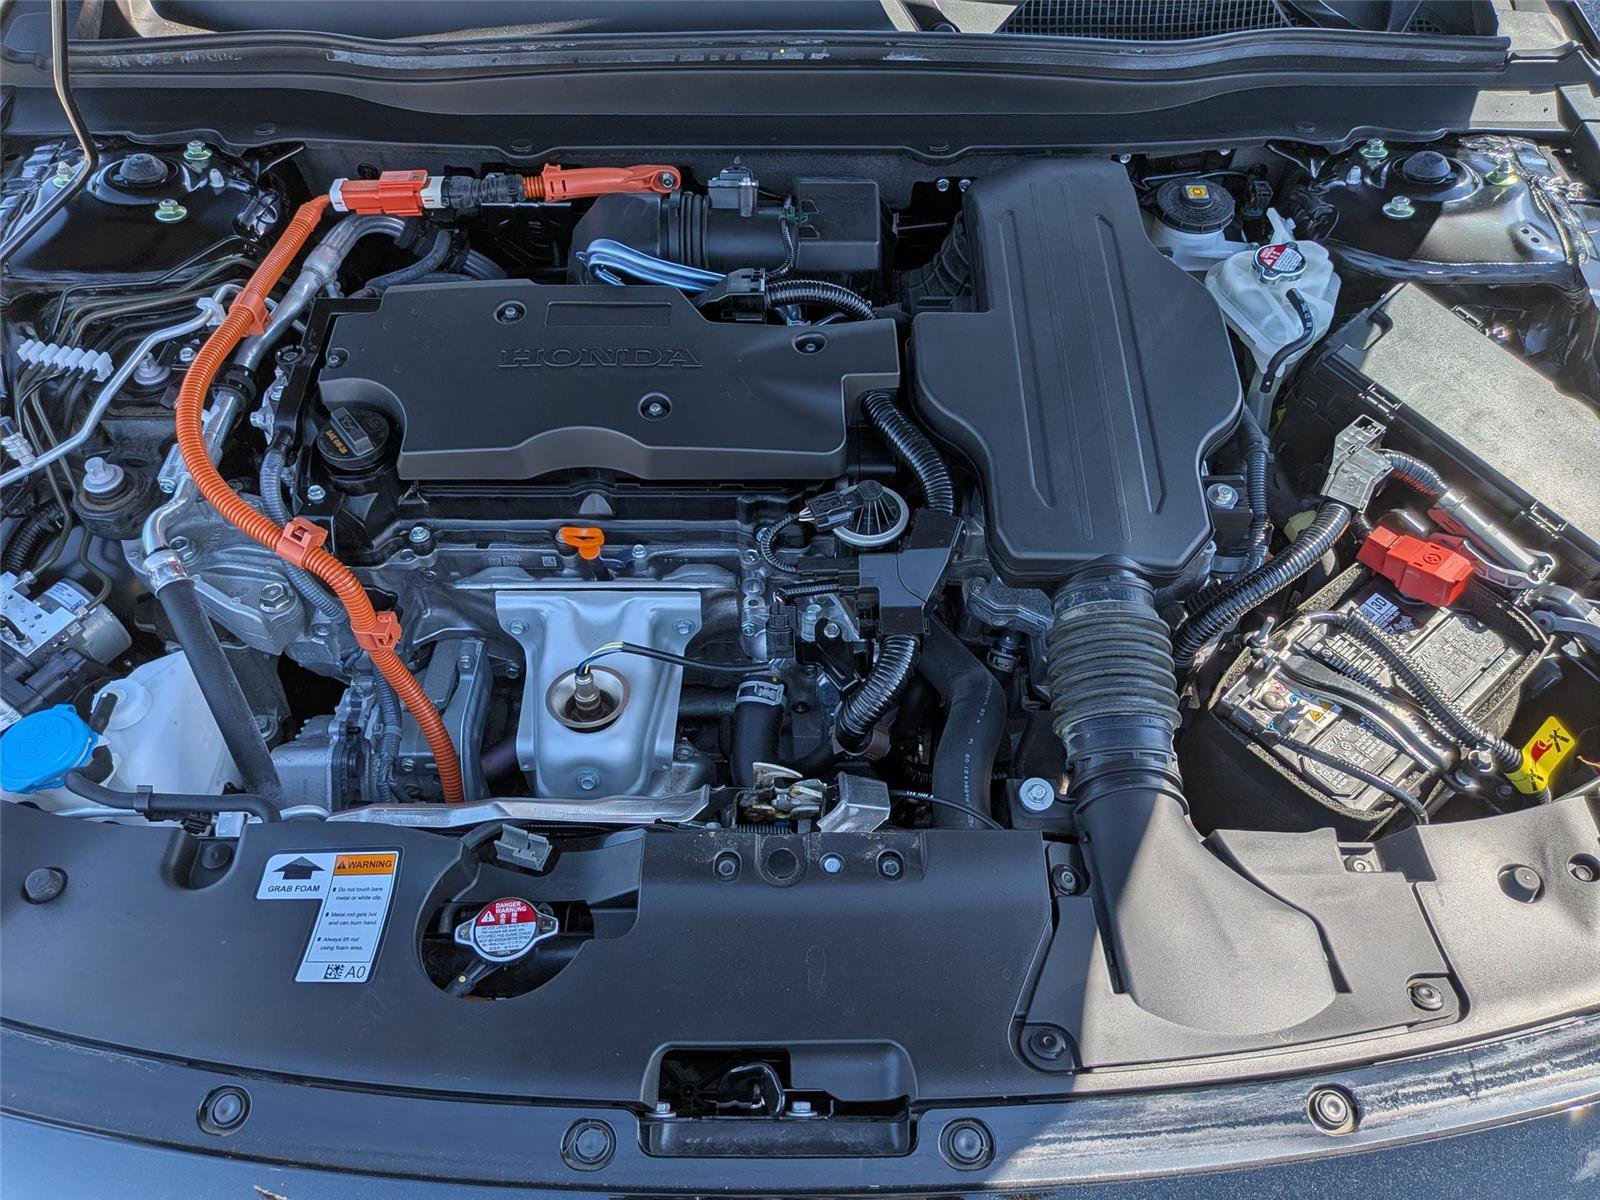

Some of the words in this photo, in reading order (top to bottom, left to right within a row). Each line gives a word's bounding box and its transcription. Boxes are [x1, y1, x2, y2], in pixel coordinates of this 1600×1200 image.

[498, 348, 704, 367] HONDA
[347, 860, 392, 869] WARNING
[267, 885, 293, 893] GRAB
[495, 905, 527, 914] WARNING
[344, 965, 366, 979] A0
